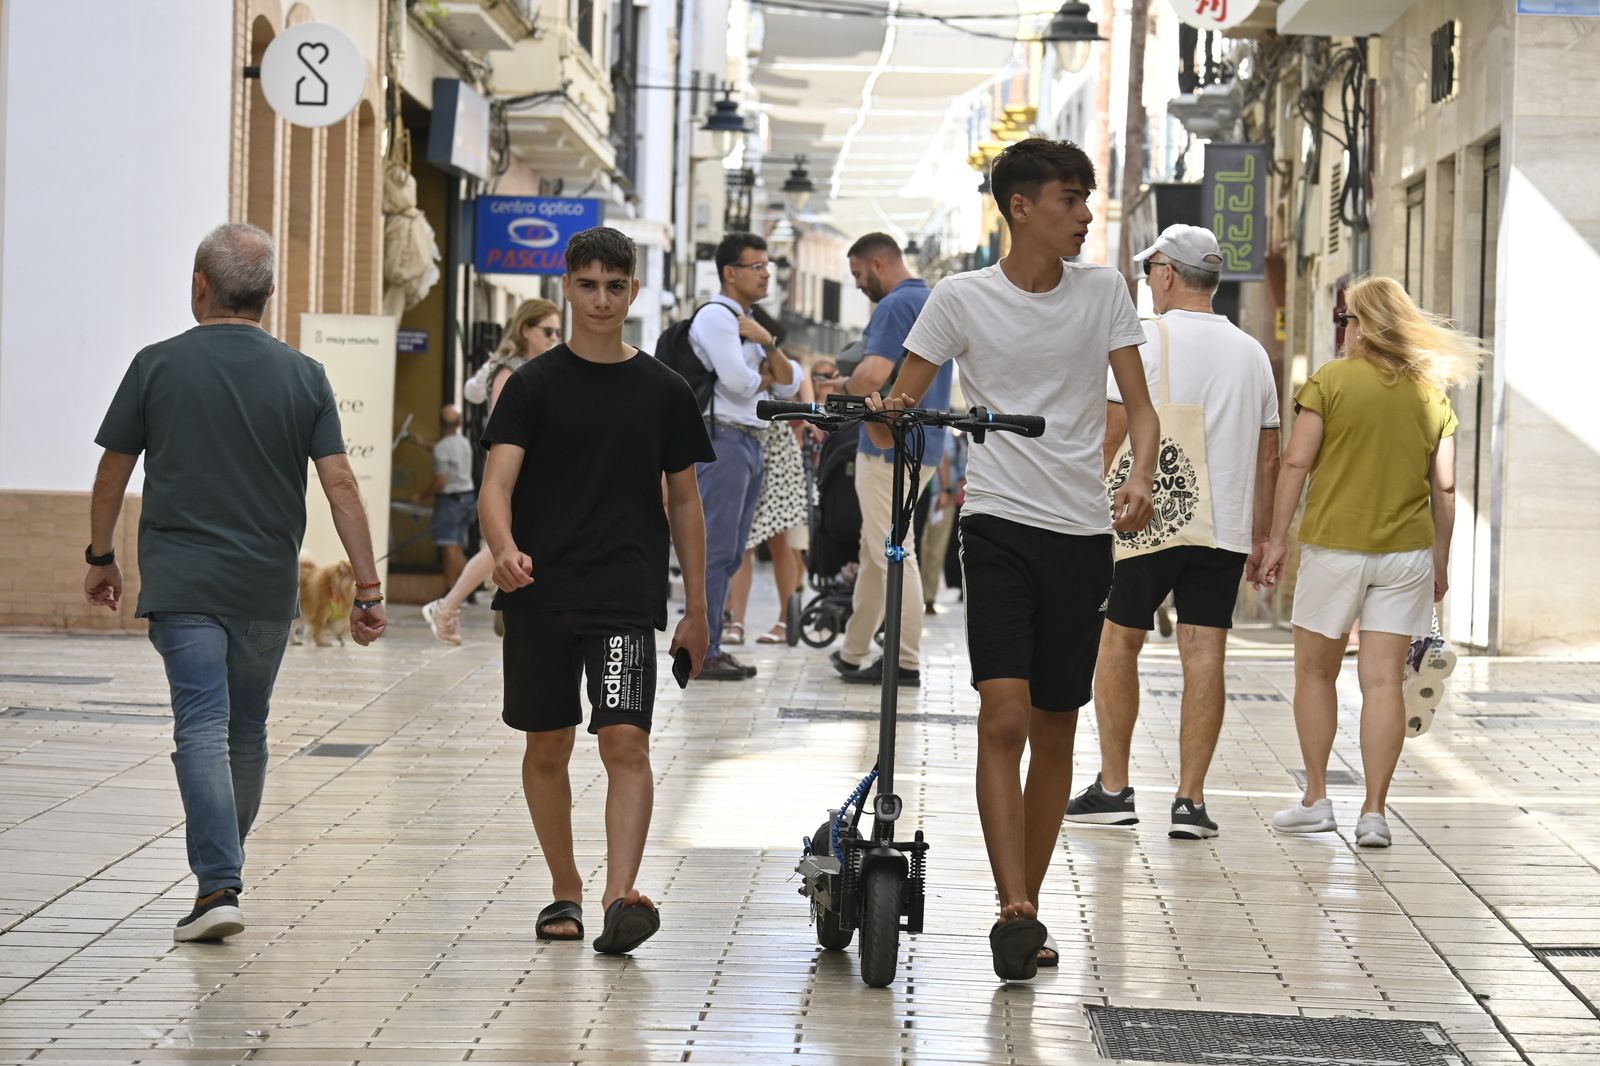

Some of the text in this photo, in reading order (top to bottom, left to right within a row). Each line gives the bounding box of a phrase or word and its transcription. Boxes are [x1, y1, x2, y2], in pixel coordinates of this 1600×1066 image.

[490, 200, 536, 214] centro
[1214, 154, 1255, 271] REEL
[334, 393, 364, 412] ce
[604, 635, 623, 708] adidas
